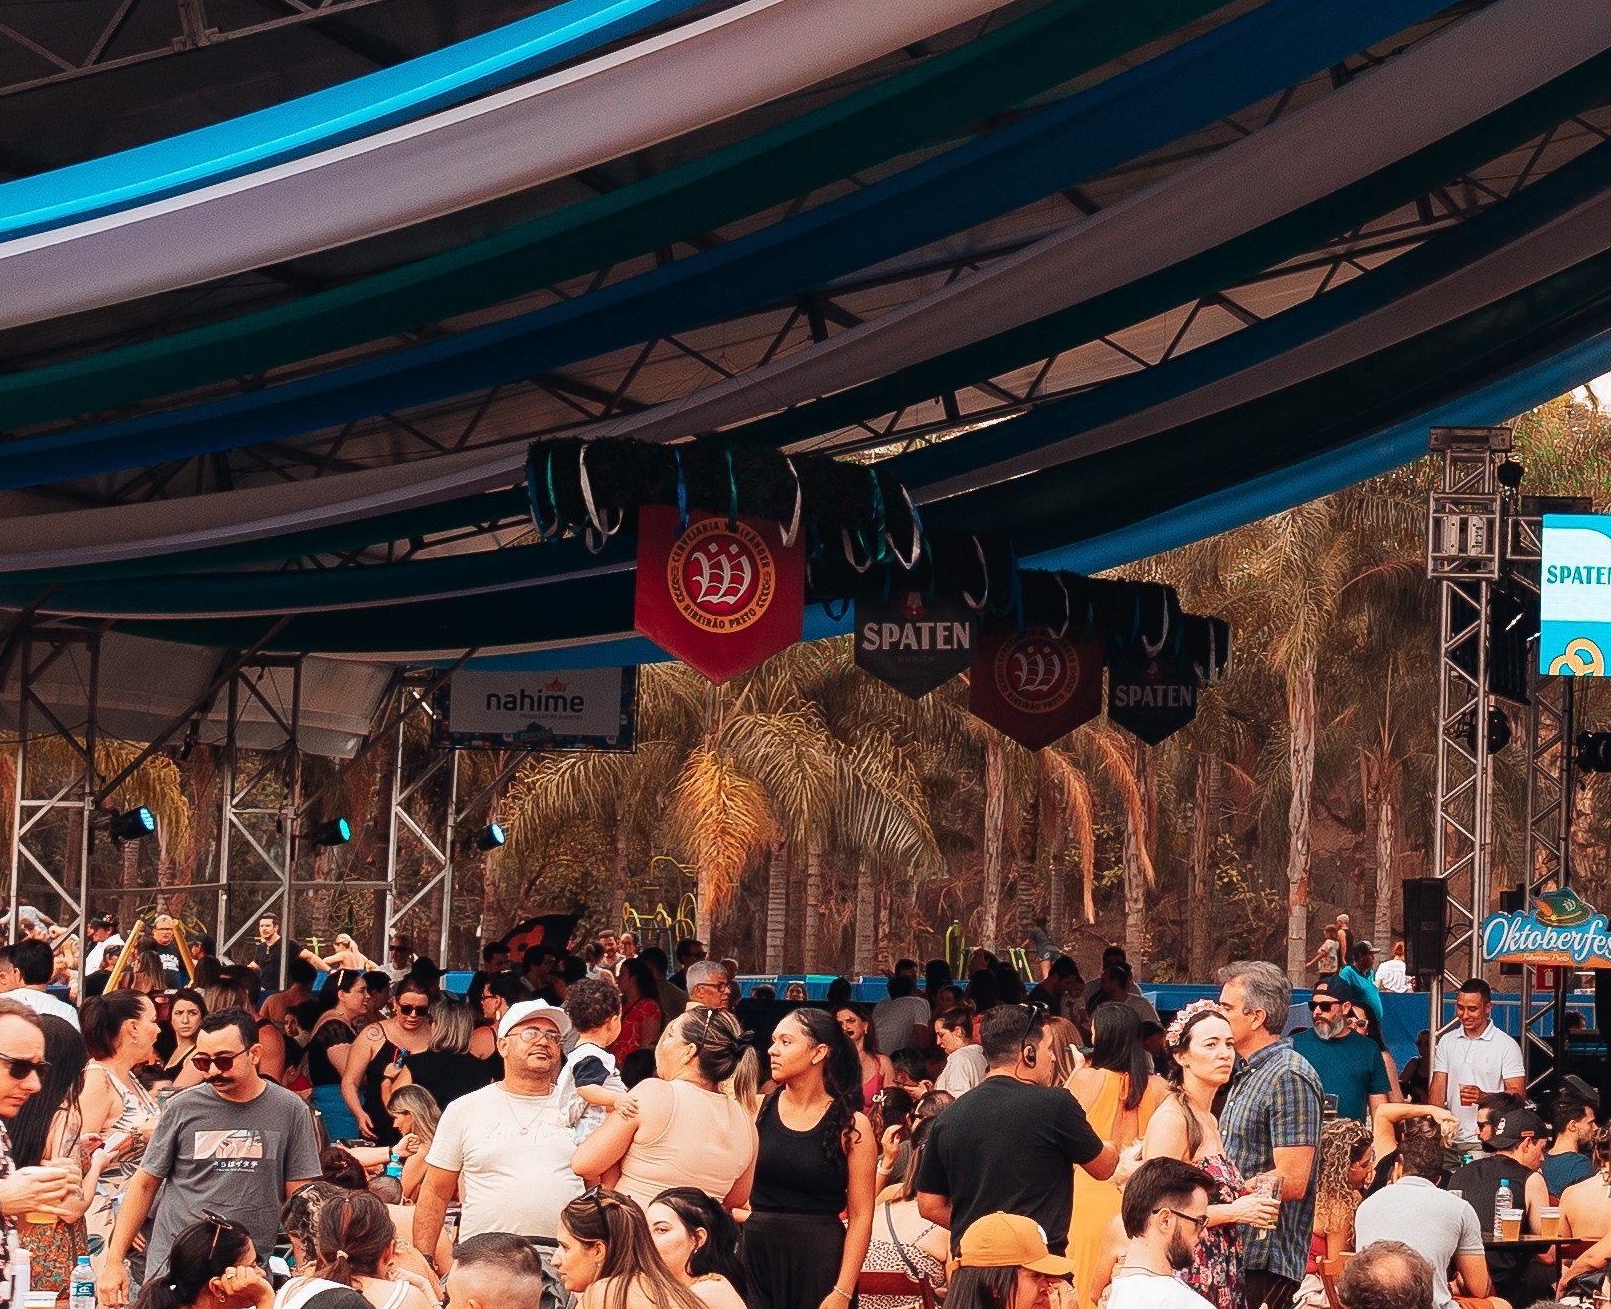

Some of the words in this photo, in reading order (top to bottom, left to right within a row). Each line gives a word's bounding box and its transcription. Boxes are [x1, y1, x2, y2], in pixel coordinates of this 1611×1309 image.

[682, 602, 726, 631] RIBEIRÃO
[728, 606, 758, 630] PRETO
[860, 621, 971, 652] SPATEN
[485, 688, 585, 713] nahime
[1114, 684, 1193, 708] SPATEN
